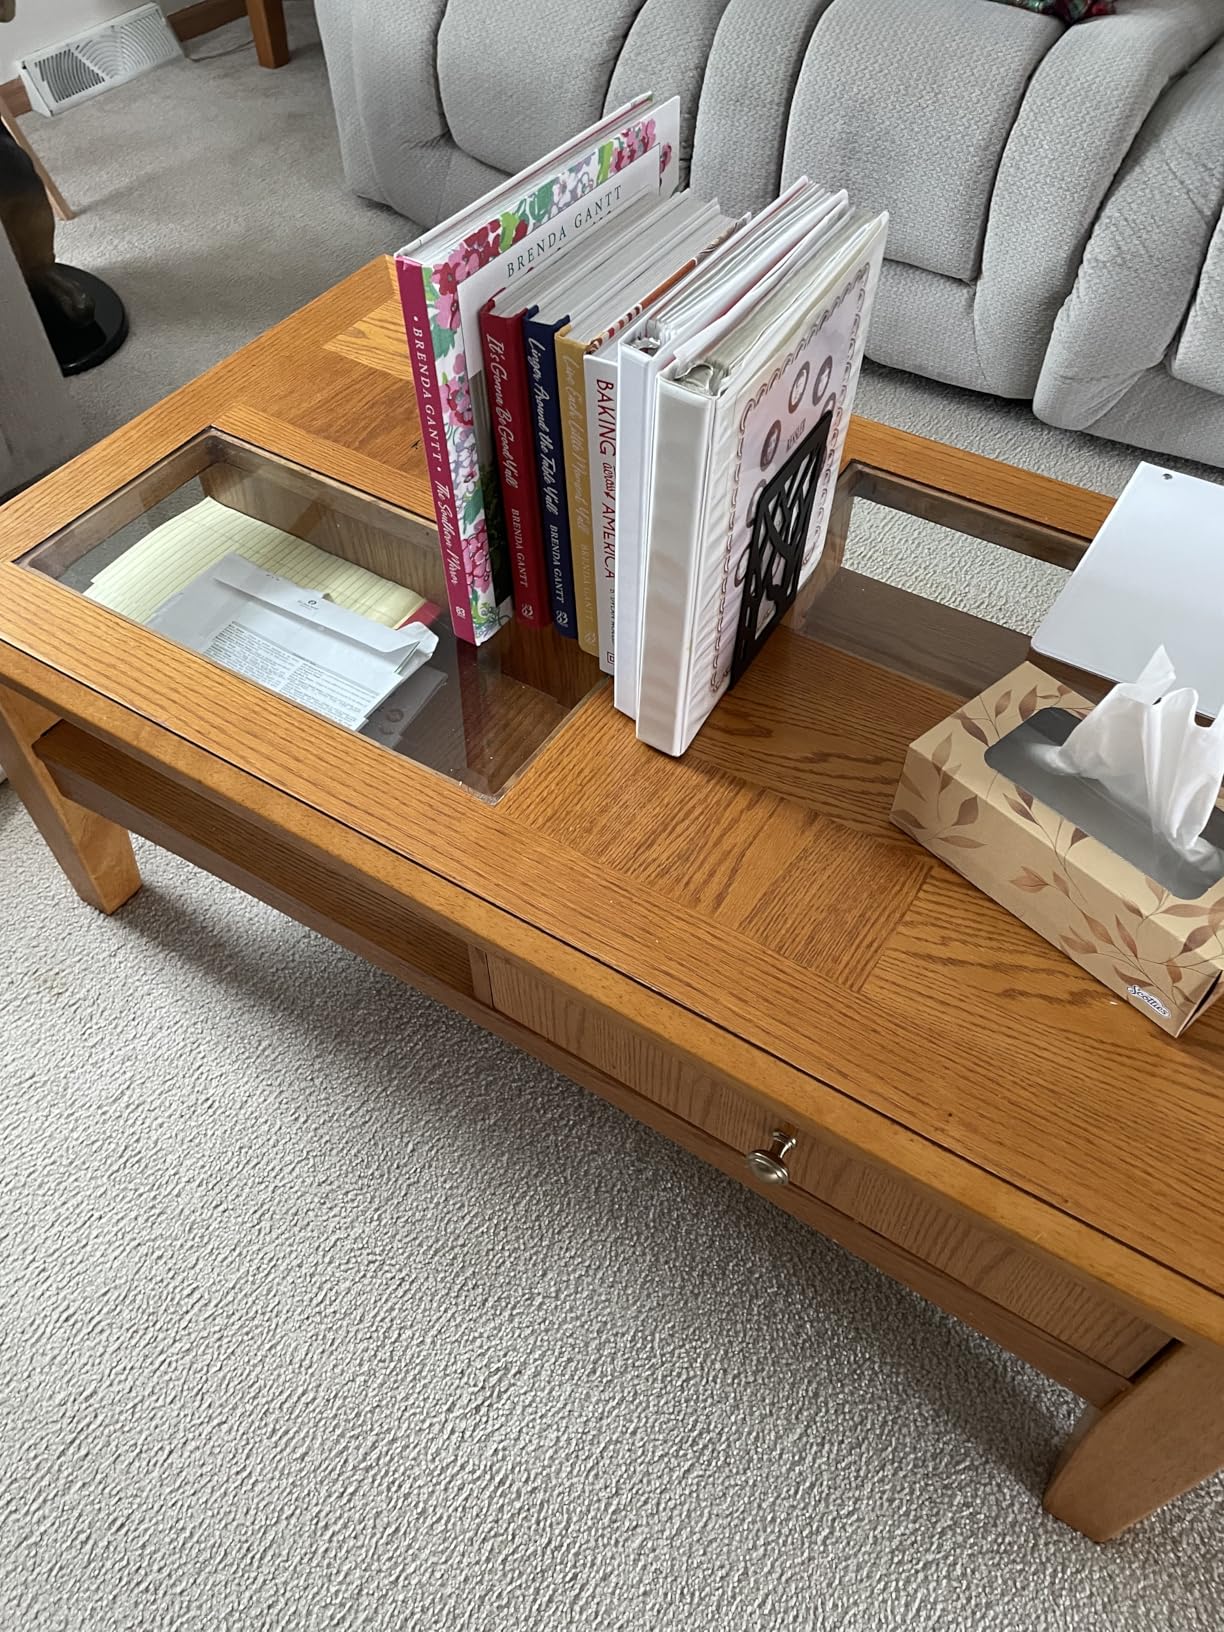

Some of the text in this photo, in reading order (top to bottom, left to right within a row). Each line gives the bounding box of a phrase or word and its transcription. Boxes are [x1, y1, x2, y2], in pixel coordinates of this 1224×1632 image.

[506, 184, 622, 279] BRENDA GANTT
[413, 326, 461, 585] BRENDA GANTT The Southern Mirror
[596, 378, 617, 457] BAKING
[486, 333, 529, 588] It's Gonna Be Good Y'all BRENDA GANTT
[527, 337, 565, 604] Linger Around the Table Y'all BRENDA GANTT
[581, 543, 593, 584] BRENDA
[602, 502, 616, 578] AMERICA
[583, 585, 594, 622] GANTT
[1126, 984, 1168, 1016] Scotties
